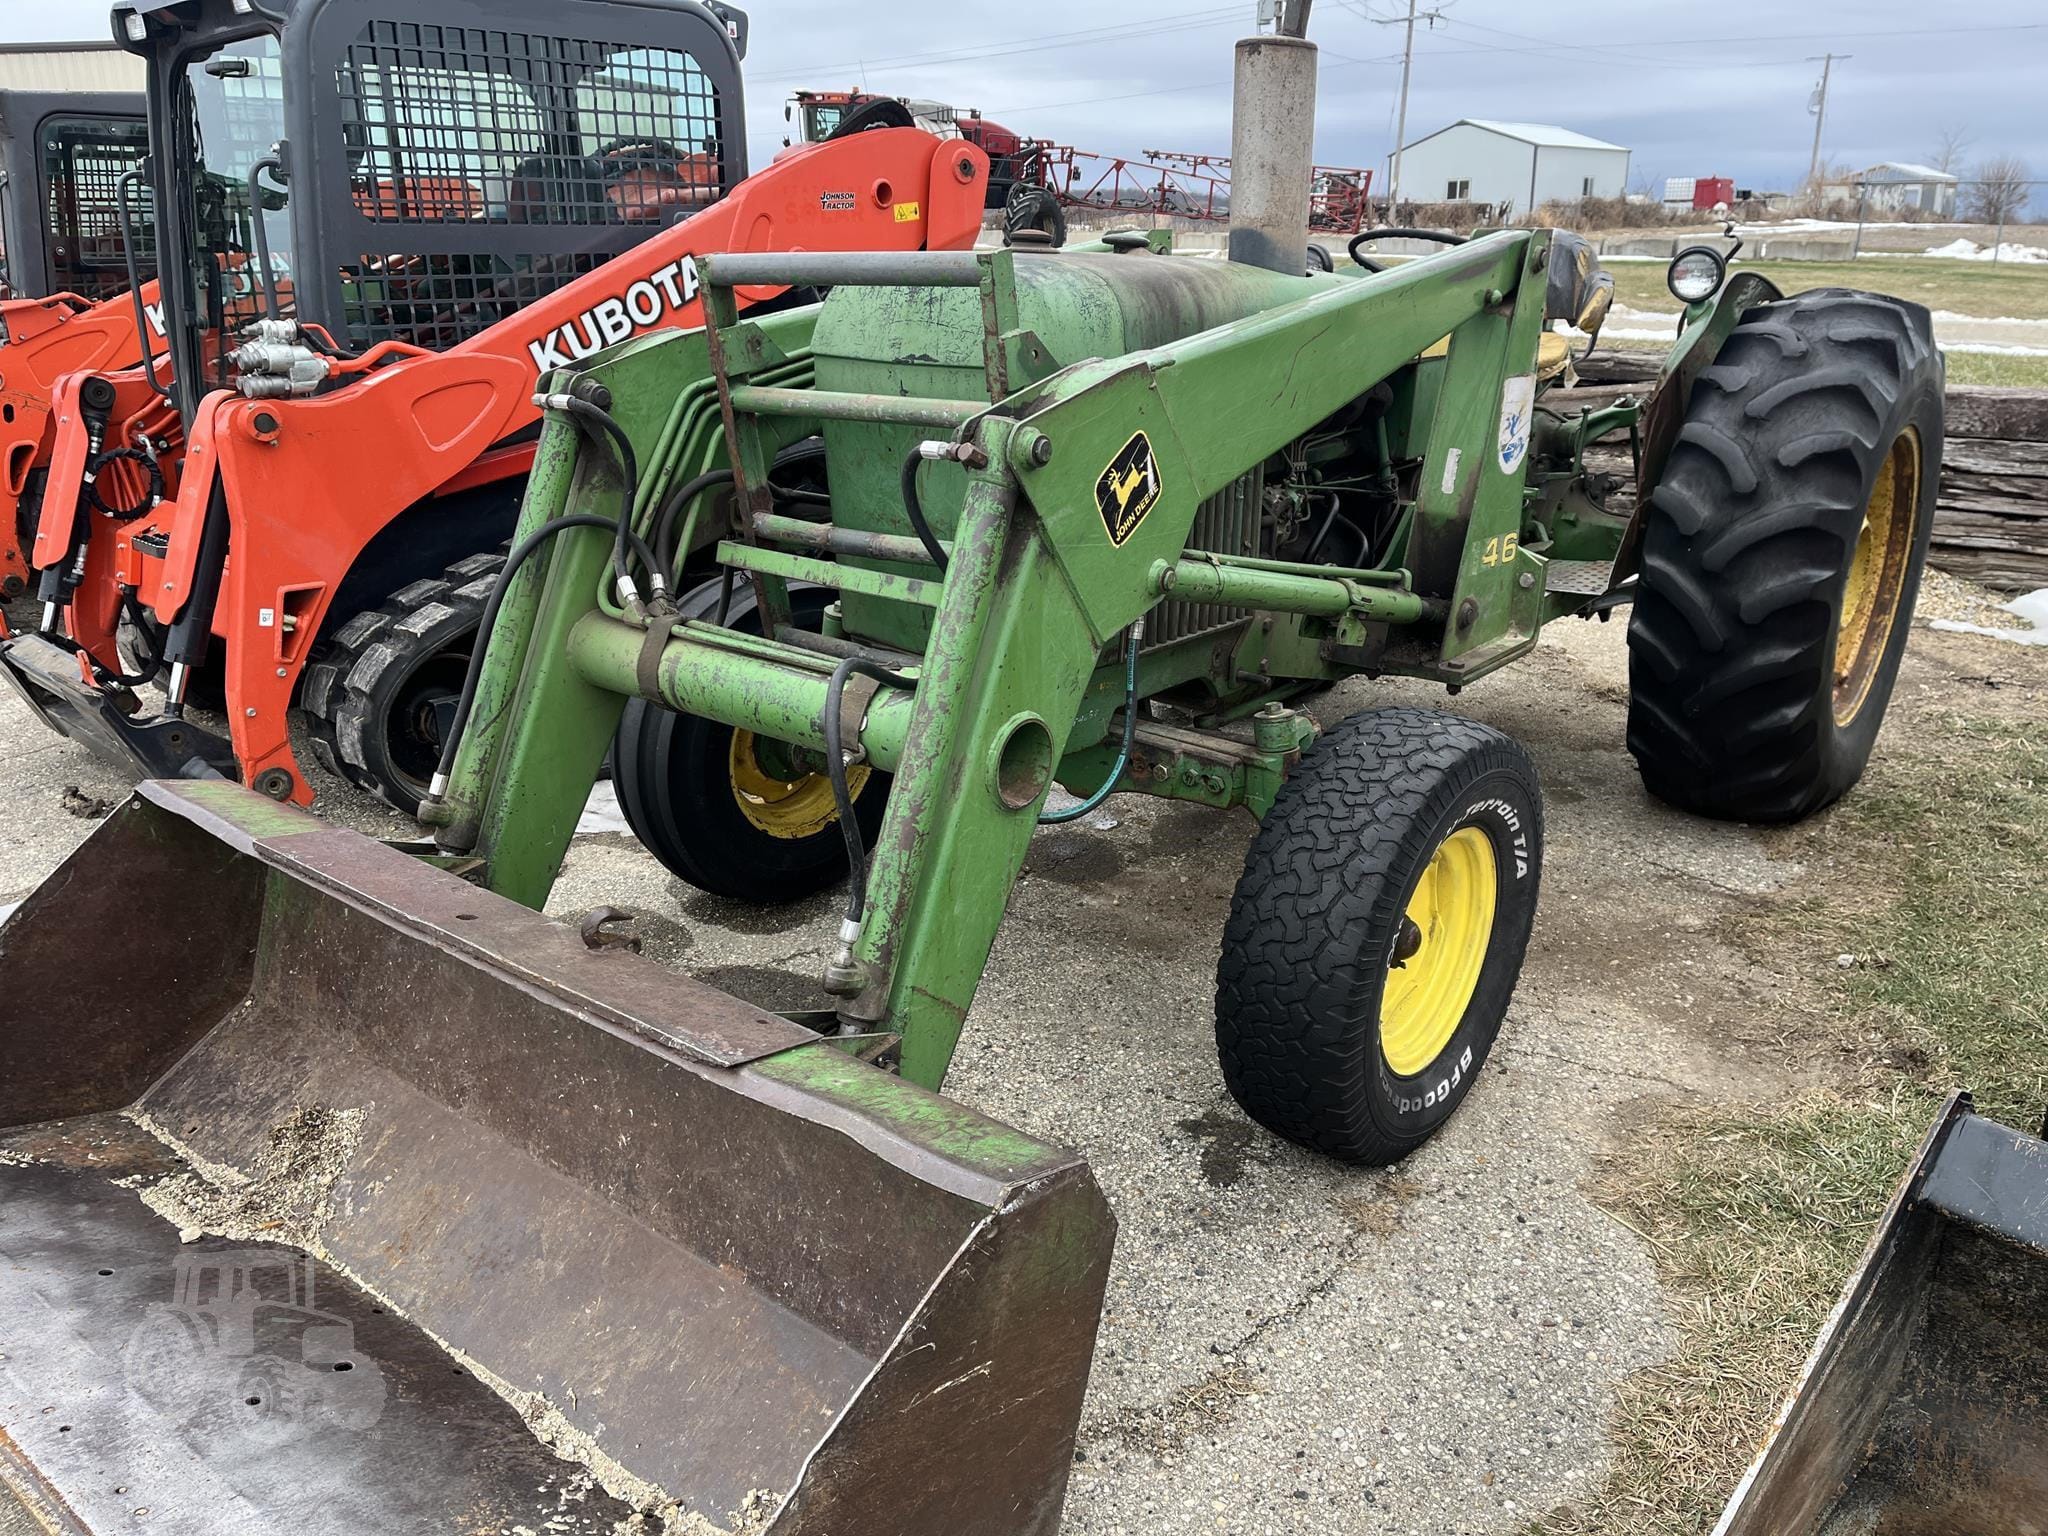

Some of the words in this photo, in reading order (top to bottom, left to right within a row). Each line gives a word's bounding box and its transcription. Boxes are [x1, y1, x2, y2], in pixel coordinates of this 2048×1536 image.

[820, 191, 855, 201] JOHNSON
[821, 200, 855, 210] TRACTOR
[527, 253, 699, 373] KUBOTA
[1116, 513, 1136, 542] JOHN
[1135, 482, 1159, 515] DEERE
[1513, 832, 1528, 880] T/A
